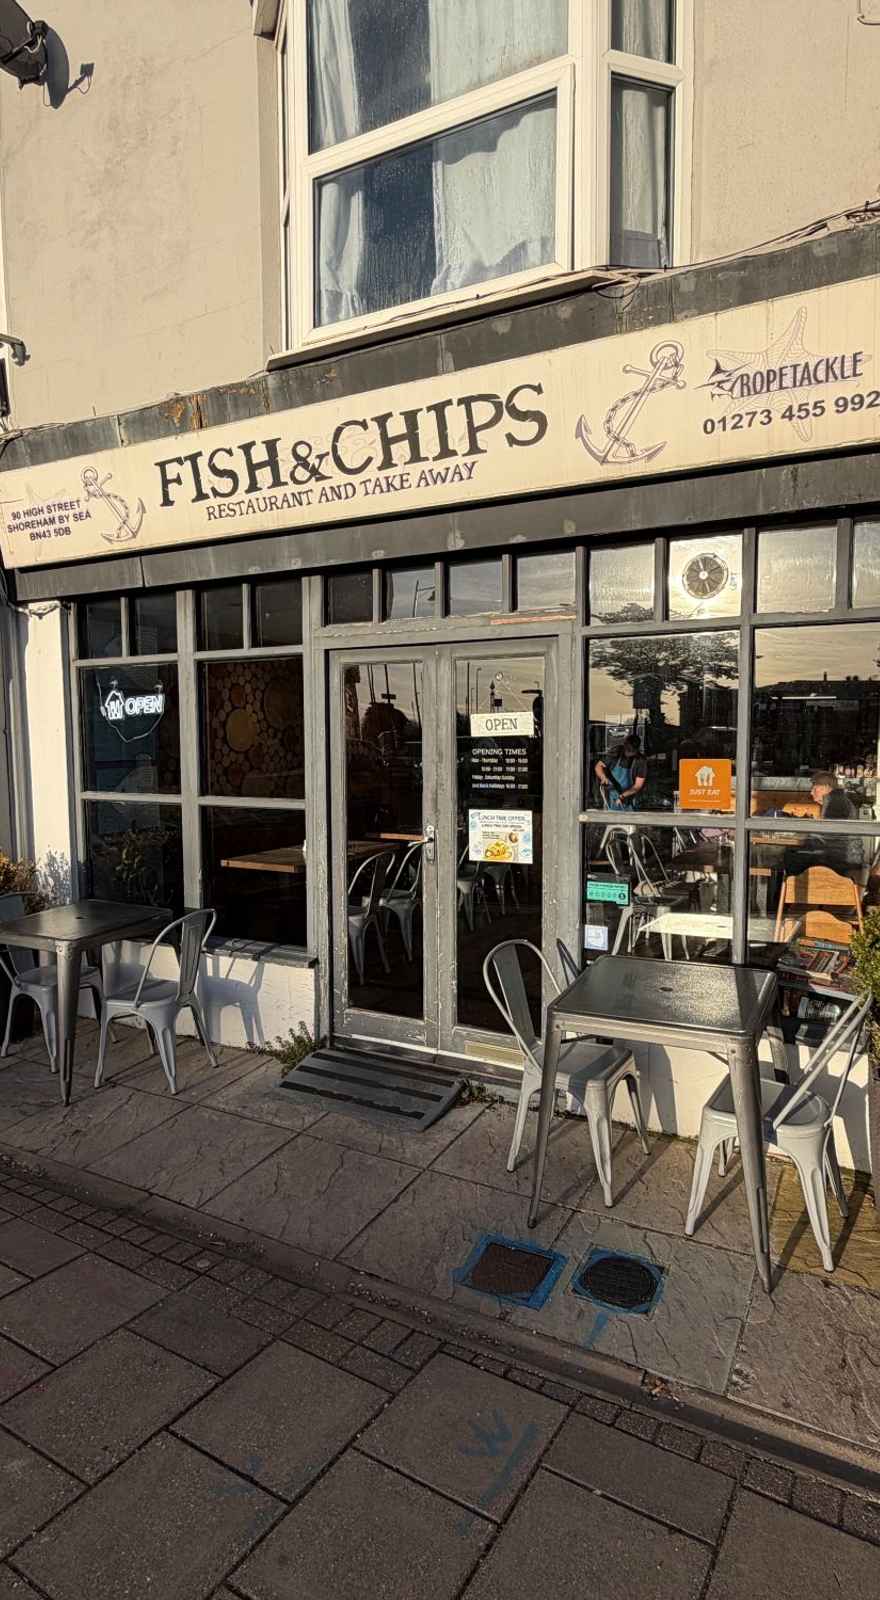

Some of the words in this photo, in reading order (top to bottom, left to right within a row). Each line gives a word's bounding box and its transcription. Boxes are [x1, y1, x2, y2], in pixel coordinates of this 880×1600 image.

[730, 351, 864, 399] ROPETACKLE
[703, 409, 773, 435] 01273
[781, 400, 826, 421] 455
[834, 390, 880, 414] 992
[206, 488, 315, 521] RESTAURANT
[317, 482, 356, 505] AND
[362, 473, 412, 496] TAKE
[415, 460, 479, 488] AWAY
[11, 511, 21, 521] 90
[22, 506, 45, 519] HIGH
[46, 499, 80, 514] STREET
[7, 516, 56, 533] SHOREHAM
[58, 514, 70, 524] BY
[72, 510, 91, 522] SEA
[29, 530, 51, 541] BN43
[53, 526, 72, 537] 5DB
[125, 694, 164, 716] OPEN
[485, 718, 517, 731] OPEN
[471, 748, 503, 756] OPENING
[504, 748, 527, 756] TIMES
[688, 788, 705, 796] JUST
[707, 788, 720, 796] EAT
